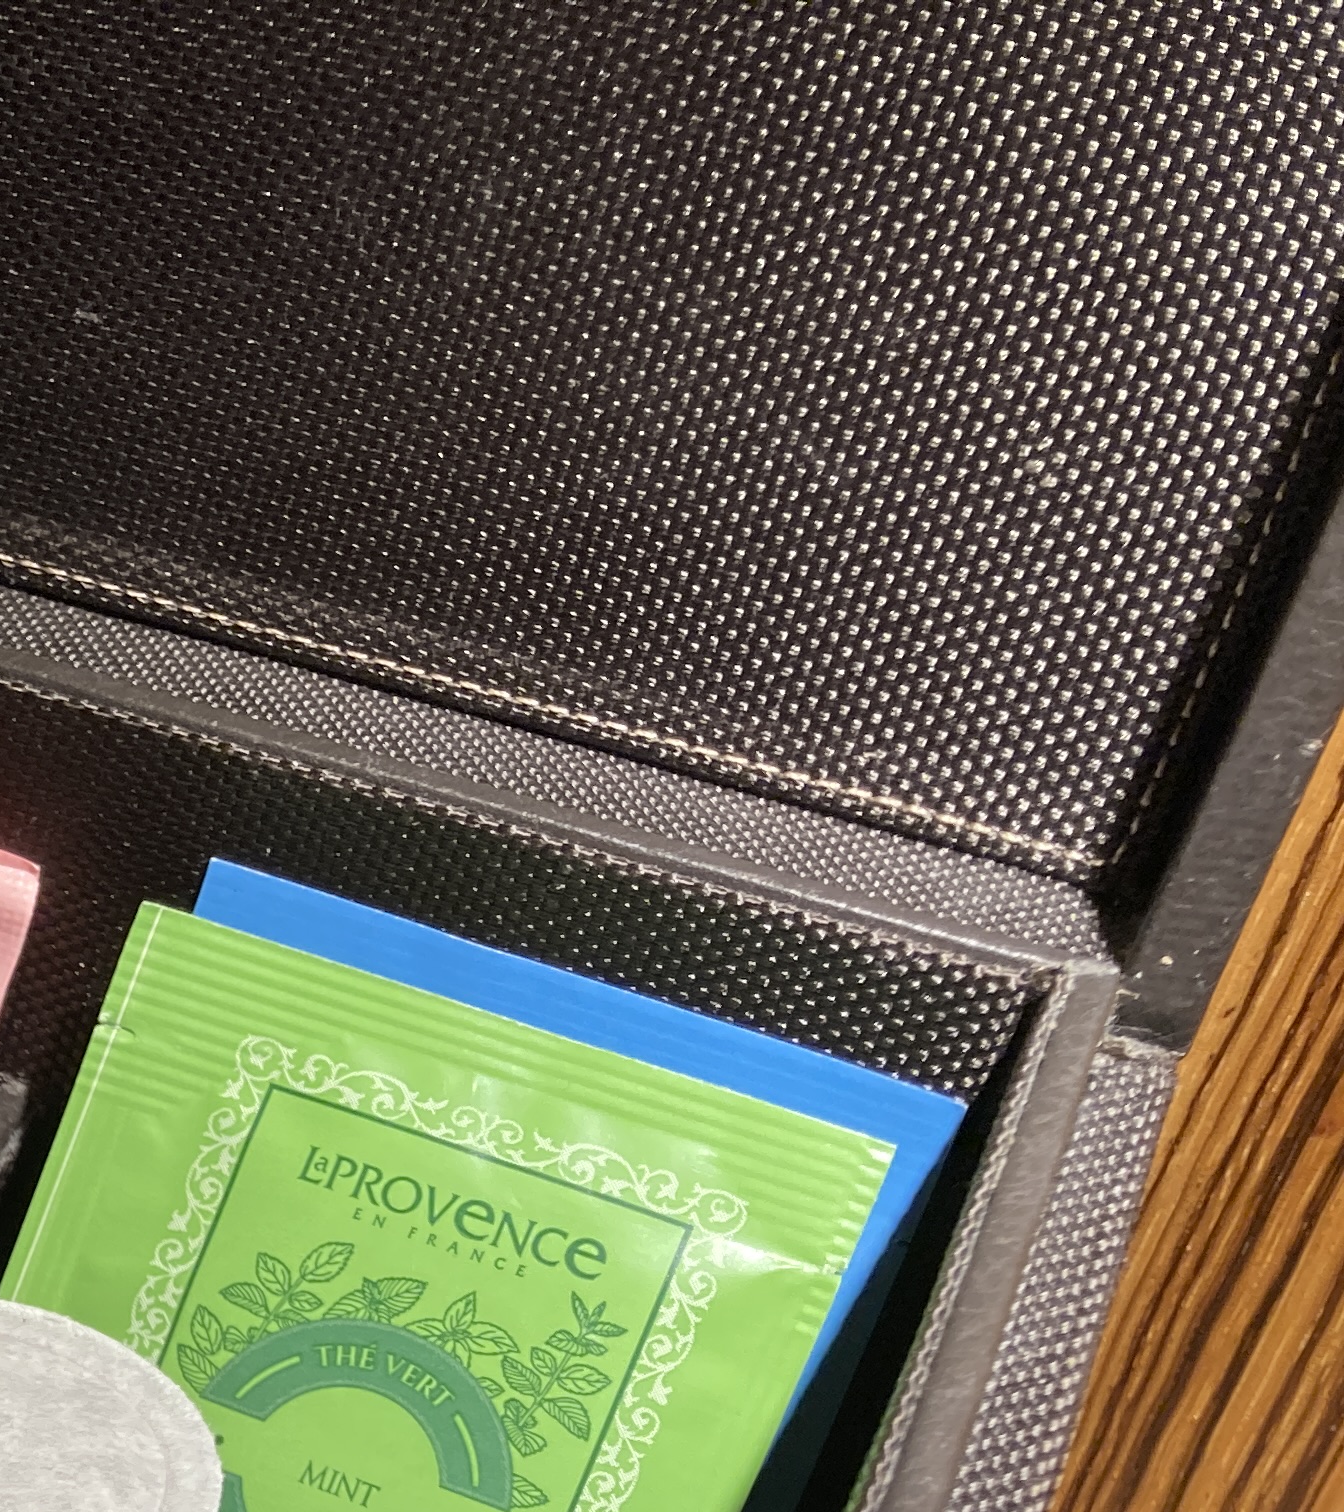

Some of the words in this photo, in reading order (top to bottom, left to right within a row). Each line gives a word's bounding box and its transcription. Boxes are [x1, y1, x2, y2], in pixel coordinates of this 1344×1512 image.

[352, 1207, 386, 1228] EN
[408, 1226, 526, 1279] FRANCE
[315, 1344, 377, 1370] THÉ
[385, 1356, 453, 1408] VERT
[297, 1460, 381, 1508] MINT
